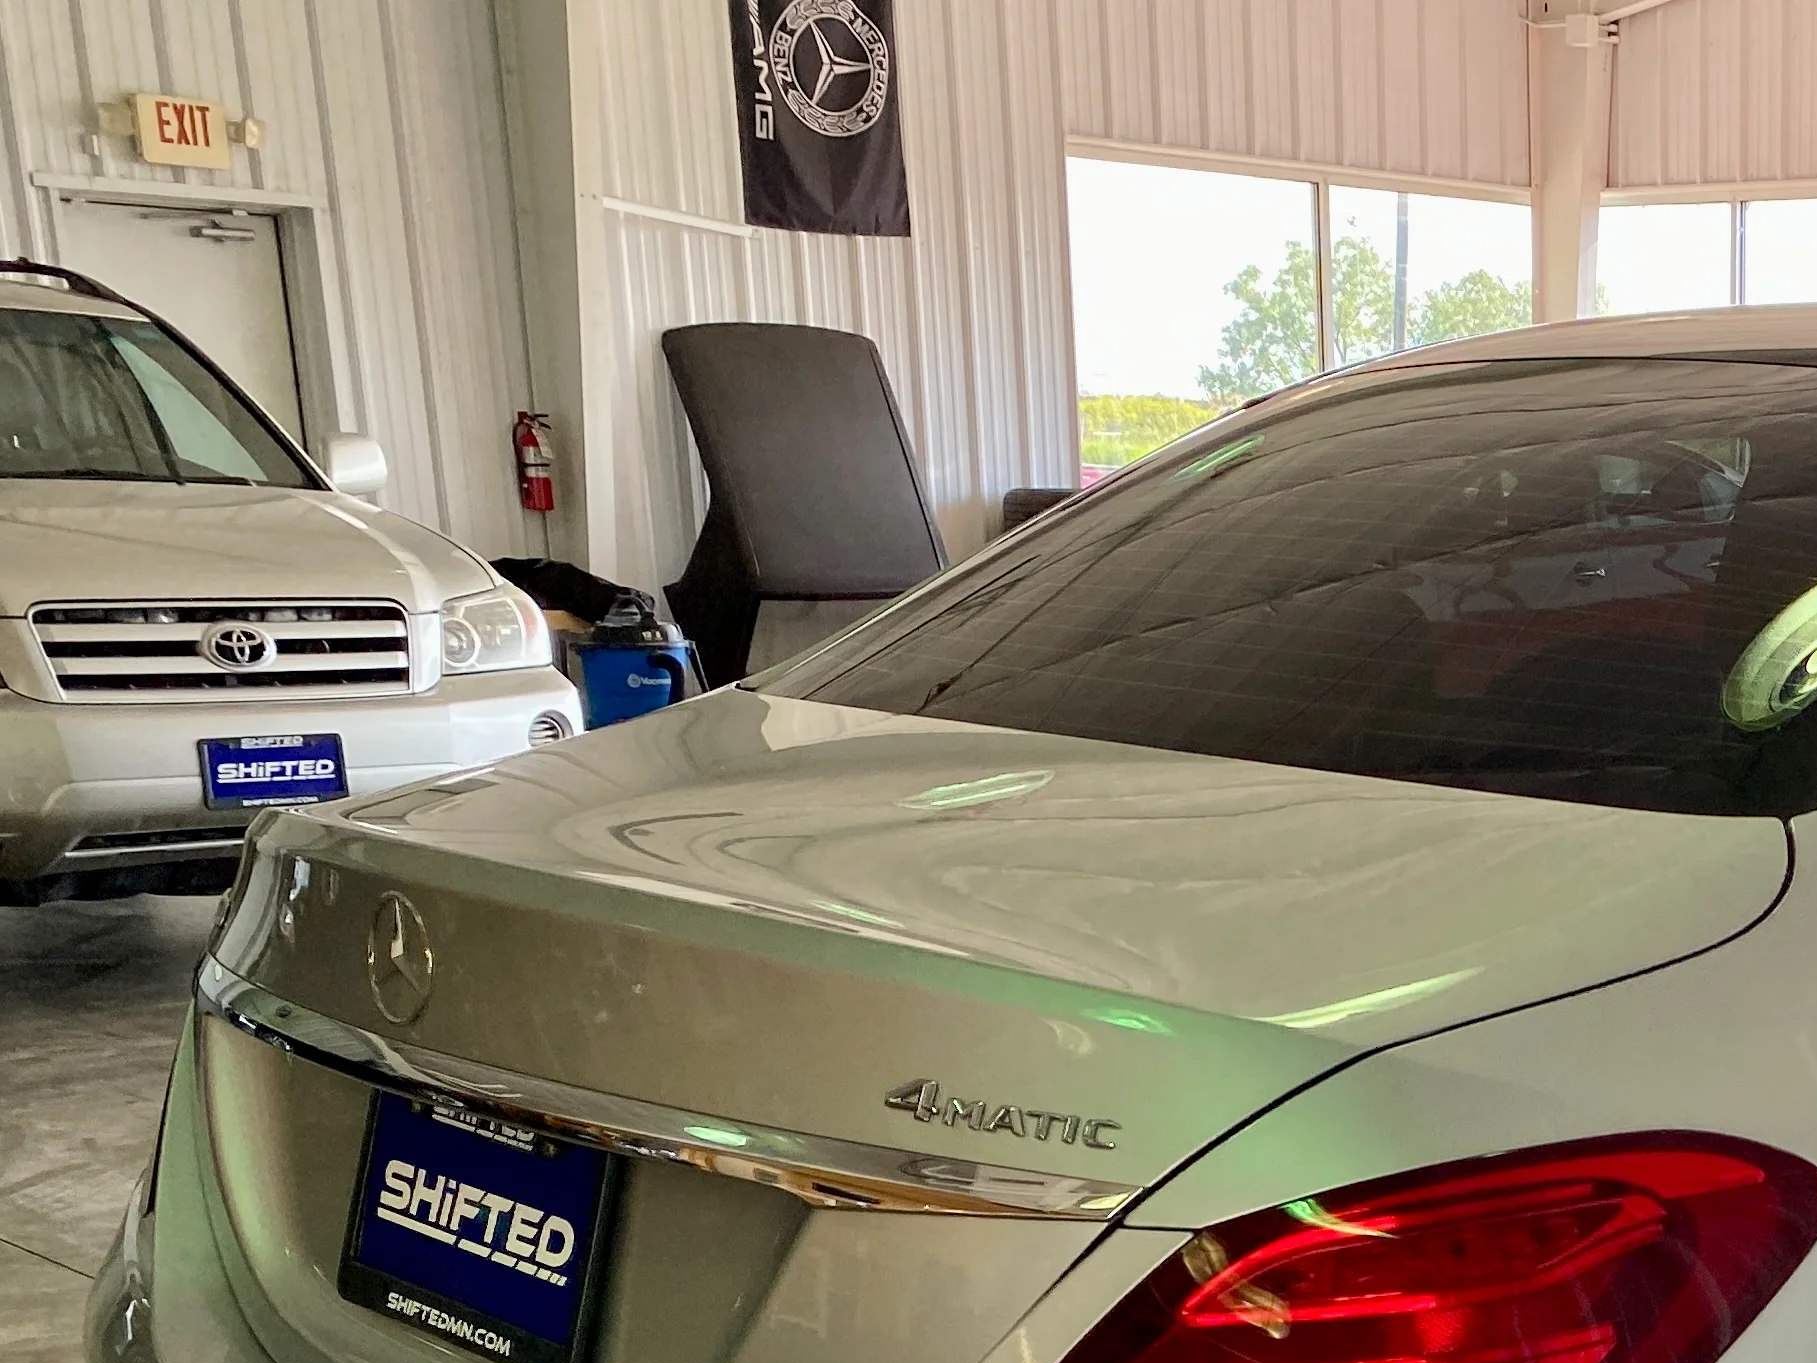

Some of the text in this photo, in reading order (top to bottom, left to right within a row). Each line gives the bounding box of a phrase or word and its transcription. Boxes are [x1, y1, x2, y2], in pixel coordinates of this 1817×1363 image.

[773, 30, 793, 85] BENZ
[852, 17, 888, 117] MERCEDES
[155, 101, 210, 147] EXIT
[884, 1078, 1122, 1150] 4MATIC
[387, 1292, 511, 1357] SHIFTEDMN.COM
